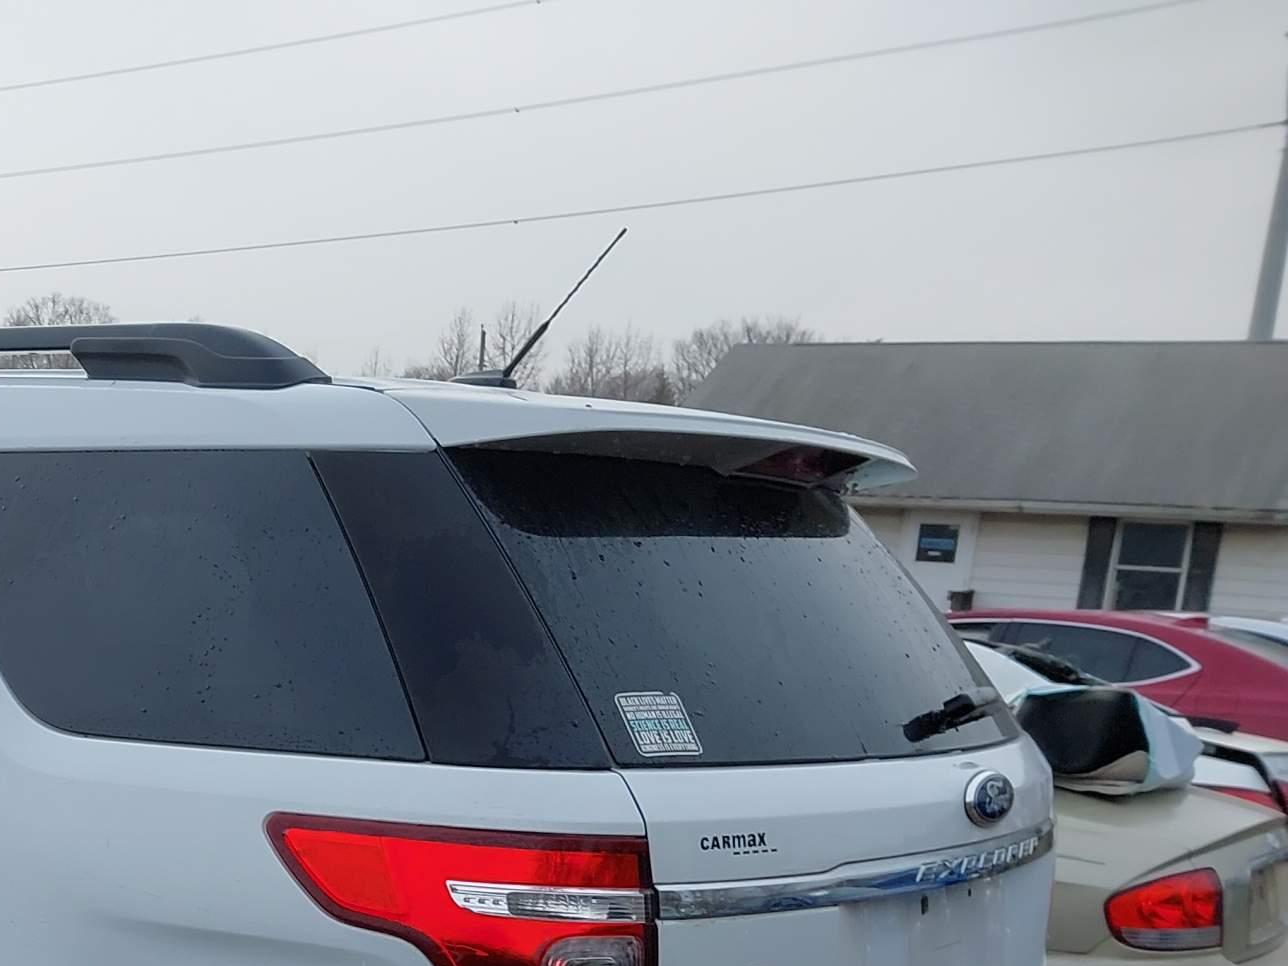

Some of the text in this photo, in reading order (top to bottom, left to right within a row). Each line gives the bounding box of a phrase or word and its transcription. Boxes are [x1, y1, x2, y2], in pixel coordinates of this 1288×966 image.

[629, 719, 690, 731] SCIENCE IS REAL
[634, 730, 695, 744] LOVE IS LOVE
[915, 836, 1039, 882] EXPLORER
